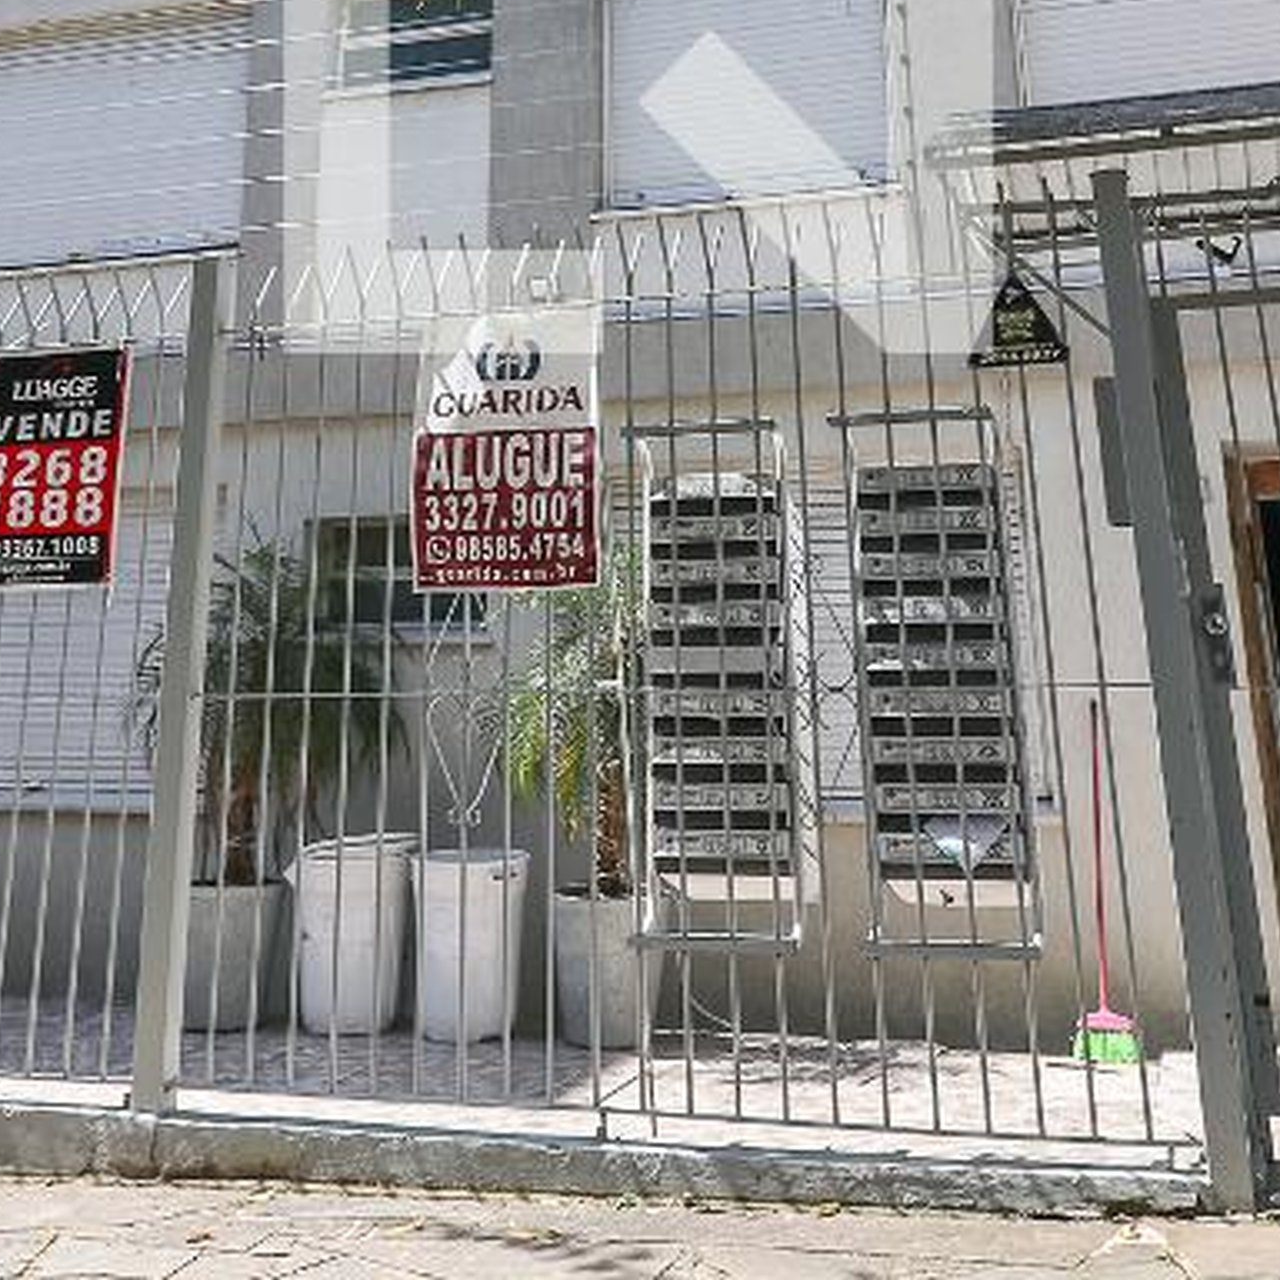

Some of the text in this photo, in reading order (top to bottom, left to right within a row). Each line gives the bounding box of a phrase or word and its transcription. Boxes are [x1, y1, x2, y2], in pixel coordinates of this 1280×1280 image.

[433, 386, 584, 418] GUARIDA
[425, 432, 585, 491] ALUGUE
[425, 491, 585, 531] 3327.9001
